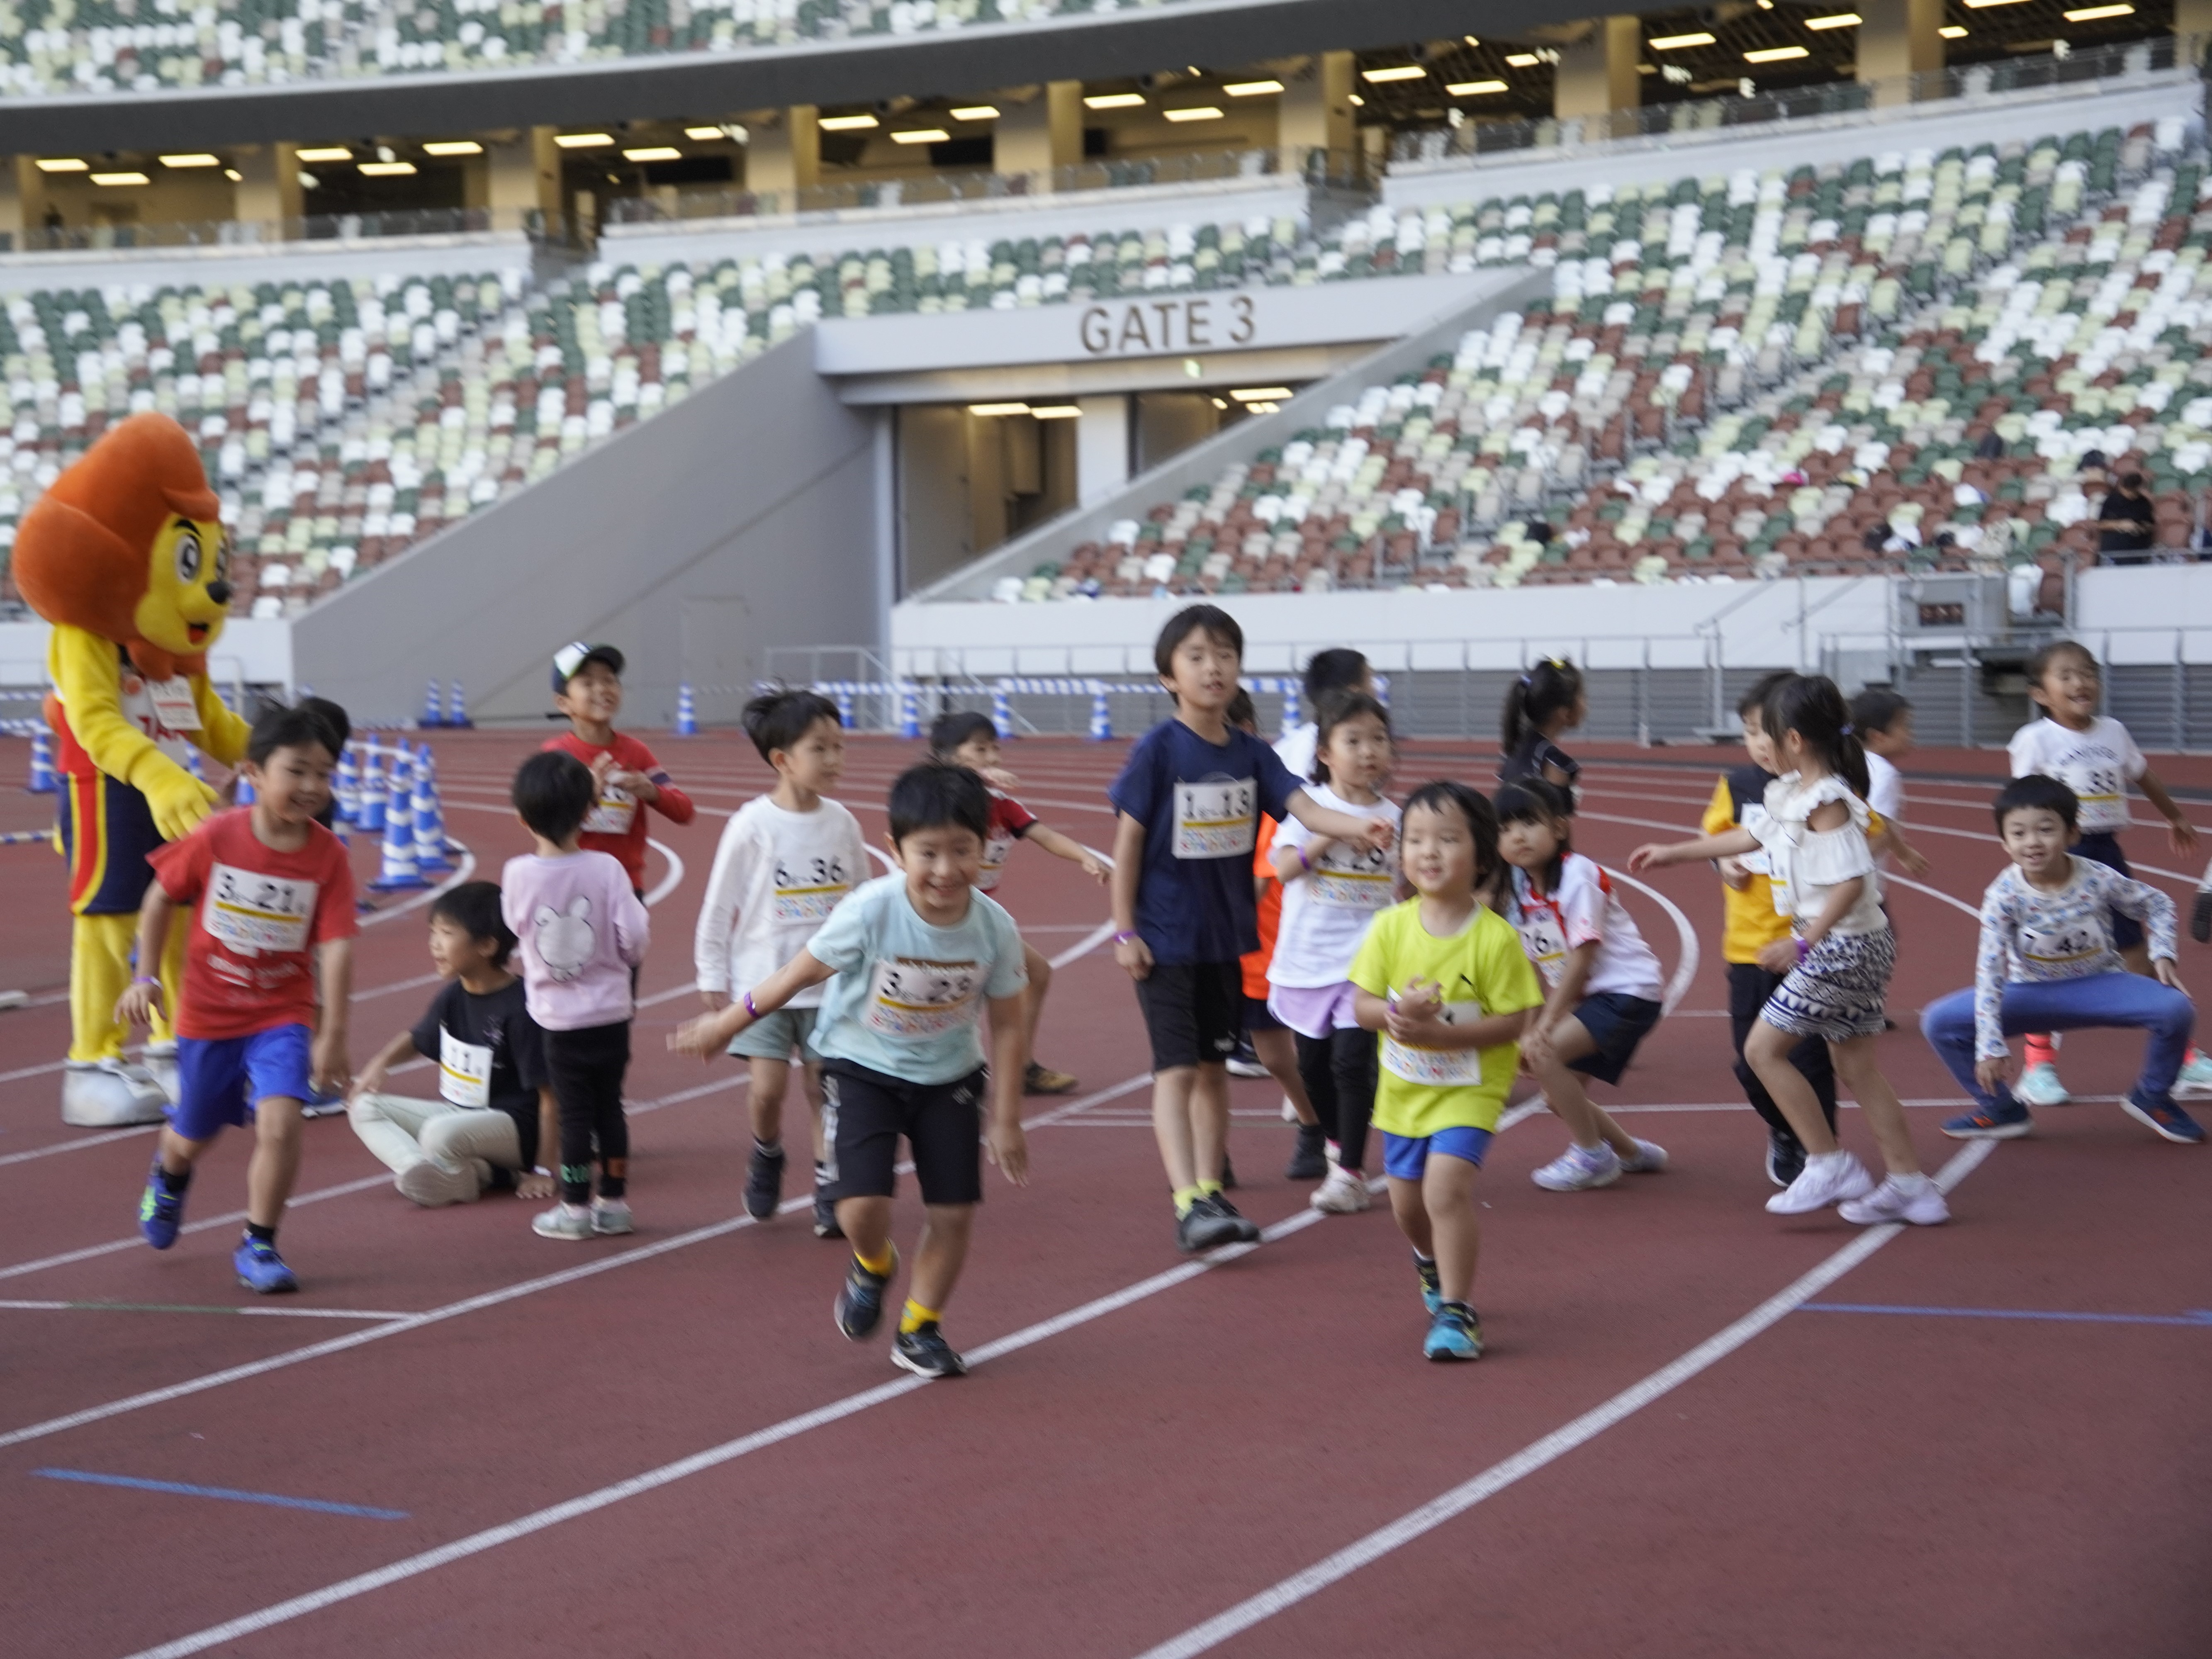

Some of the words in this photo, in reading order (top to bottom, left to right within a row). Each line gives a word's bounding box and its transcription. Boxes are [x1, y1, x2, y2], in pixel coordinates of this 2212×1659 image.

[1080, 299, 1211, 354] GATE
[1229, 295, 1256, 343] 3
[774, 859, 790, 888] 6
[810, 856, 848, 885] 36
[217, 872, 236, 902] 3
[255, 880, 295, 913] 21
[881, 968, 903, 997] 3
